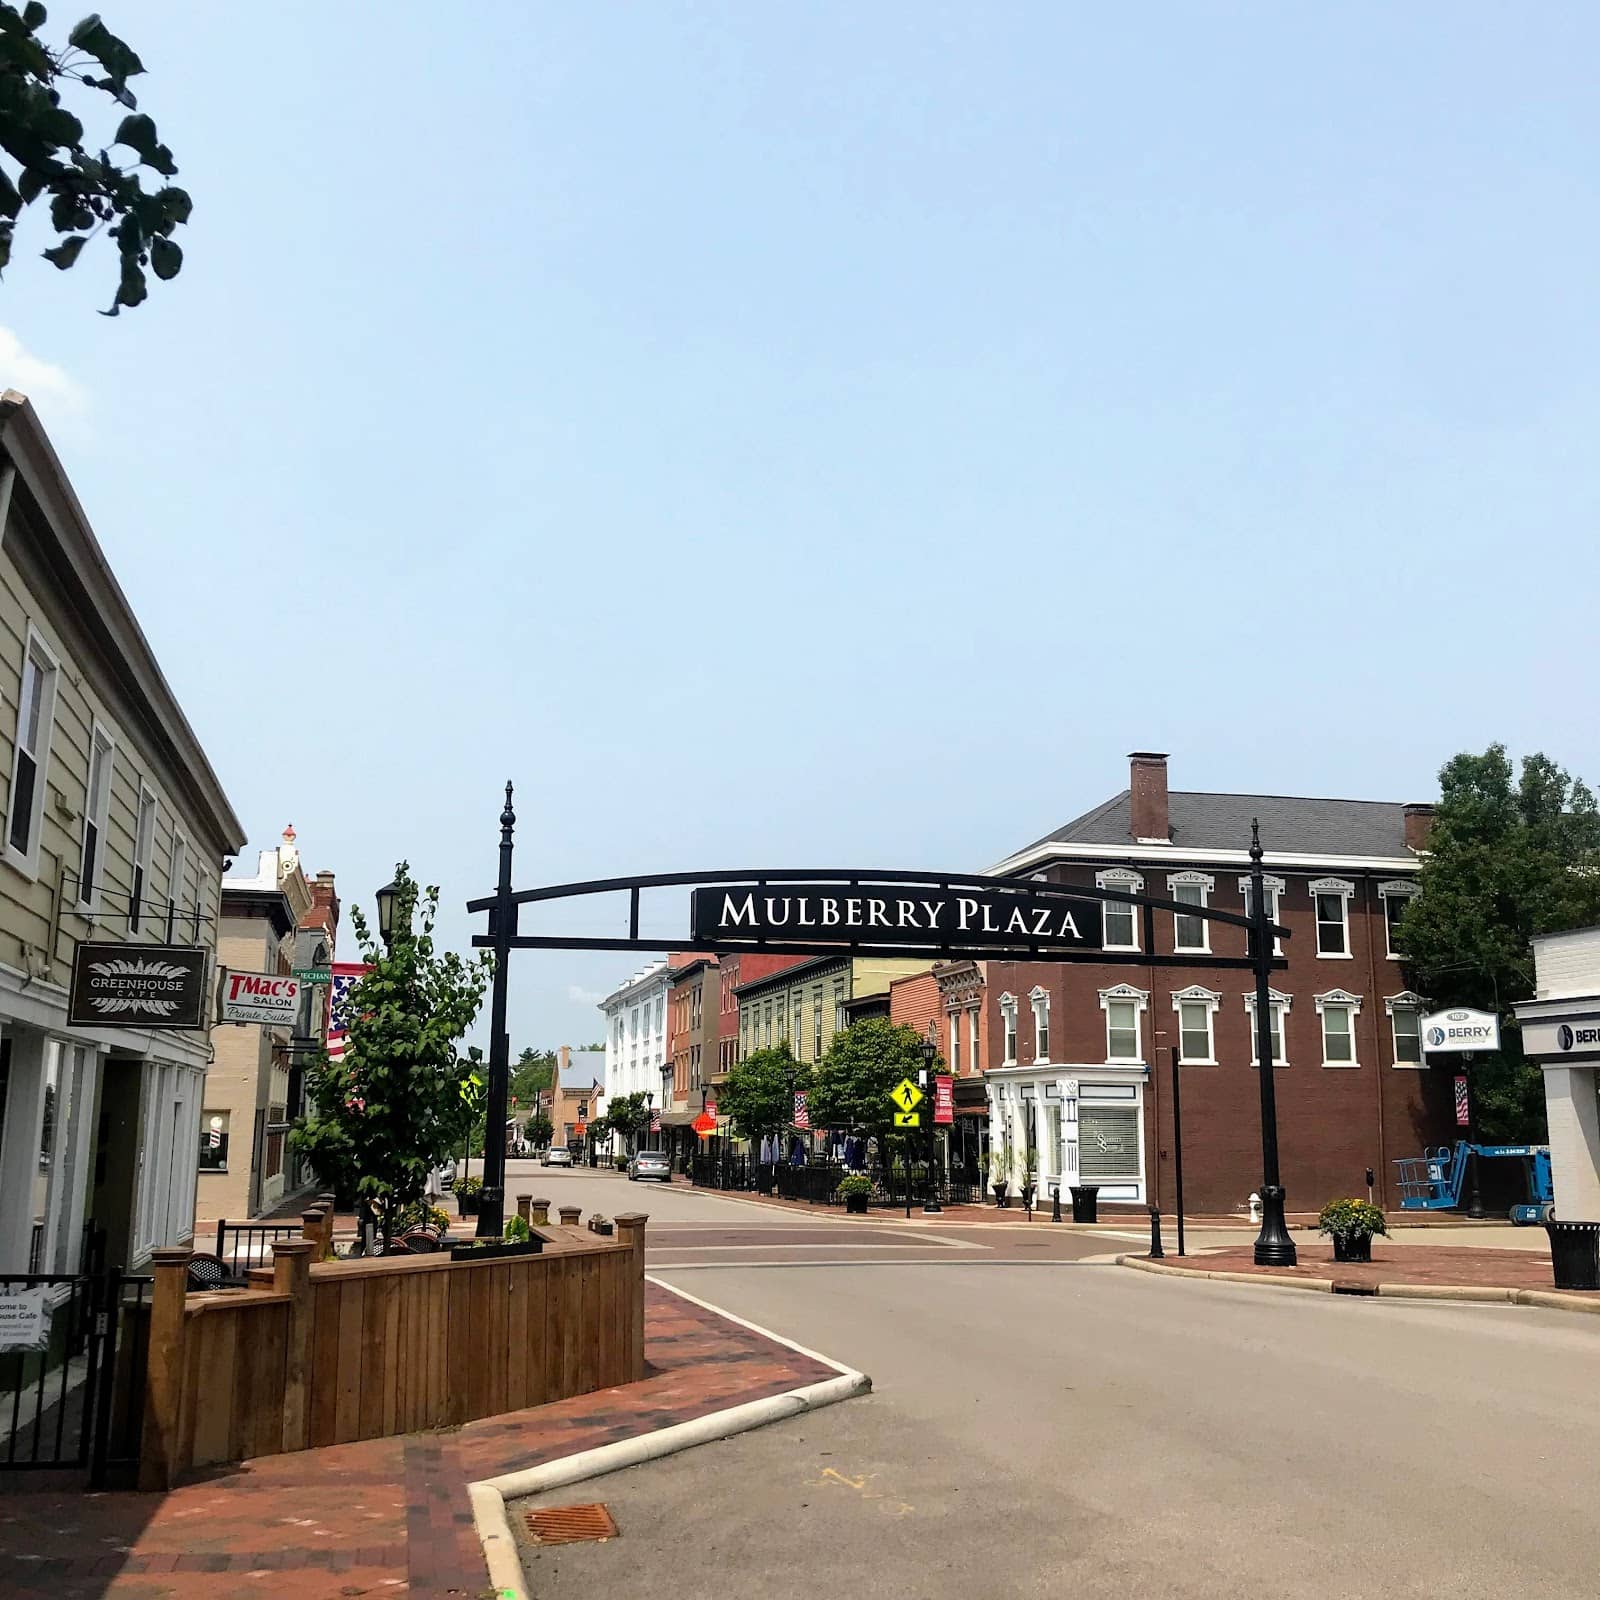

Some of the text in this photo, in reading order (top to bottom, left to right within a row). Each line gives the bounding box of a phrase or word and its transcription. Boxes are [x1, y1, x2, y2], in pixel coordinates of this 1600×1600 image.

[90, 977, 184, 991] GREENHOUSE
[116, 989, 156, 999] CAFE
[252, 996, 292, 1007] SALON
[227, 1006, 261, 1020] Private
[1448, 1026, 1492, 1038] BERRY
